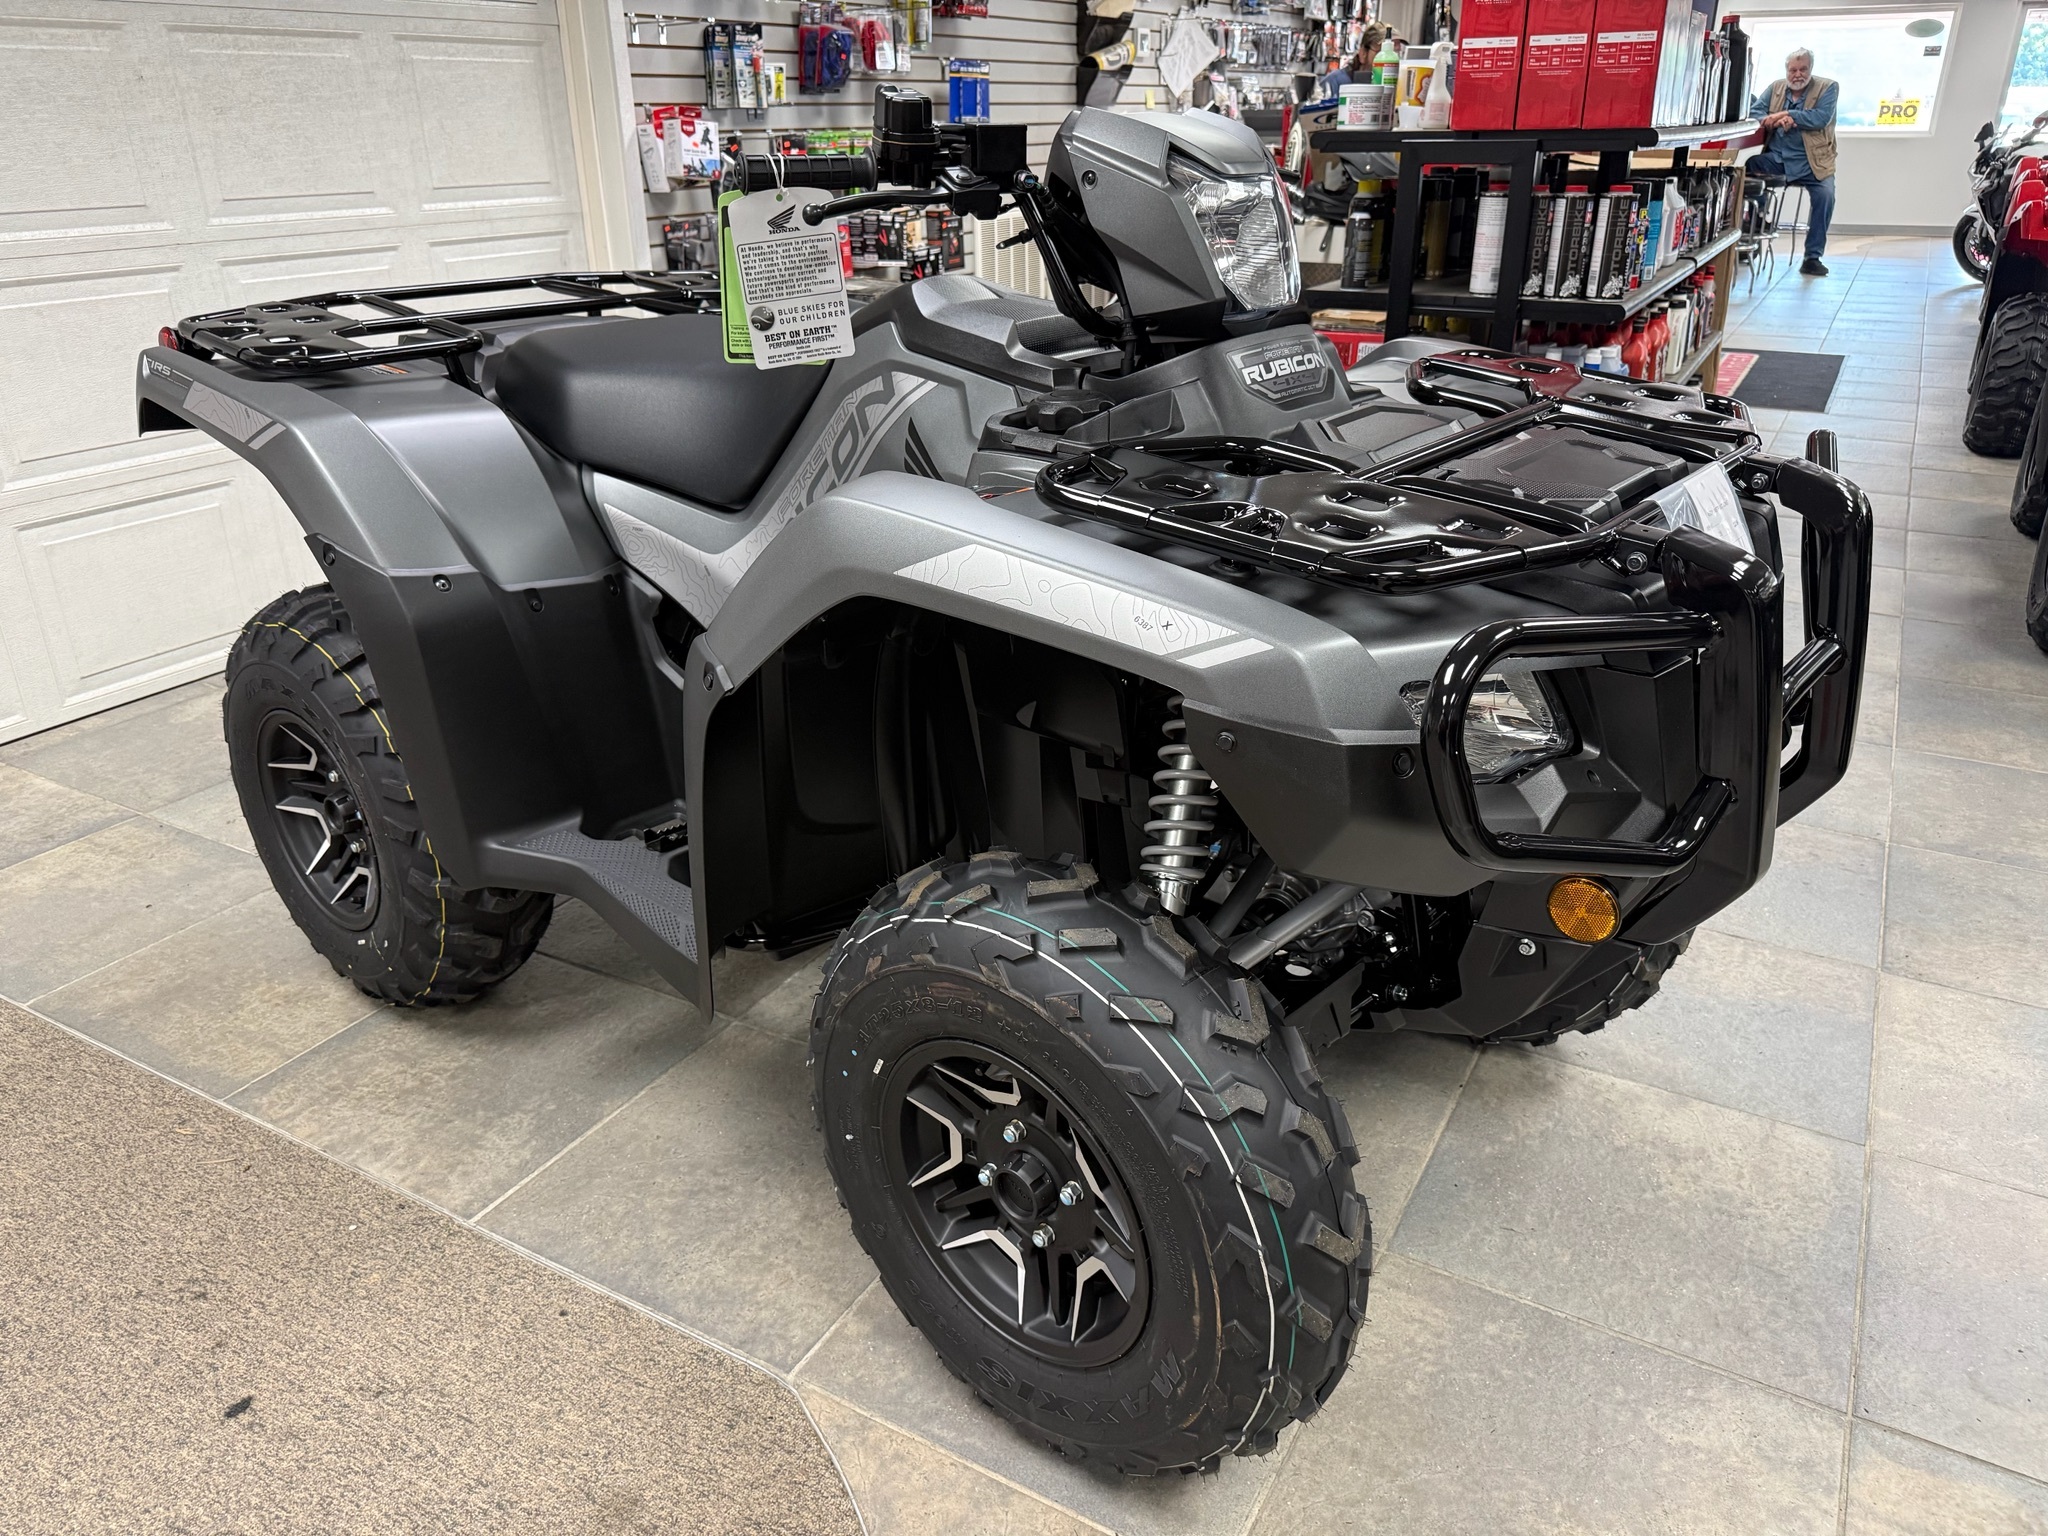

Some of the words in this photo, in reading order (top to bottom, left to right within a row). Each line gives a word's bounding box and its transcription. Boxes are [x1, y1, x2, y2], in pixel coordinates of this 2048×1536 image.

[1879, 104, 1918, 118] PRO
[769, 227, 800, 235] HONDA
[1531, 198, 1549, 276] OTORBIKE
[1567, 198, 1586, 277] OTORBIKE
[1610, 198, 1630, 277] OTORBIKE
[778, 307, 798, 316] BLUE
[801, 302, 825, 315] SKIES
[828, 300, 844, 310] FOR
[780, 317, 798, 325] OUR
[800, 309, 846, 322] CHILDREN
[764, 331, 787, 342] BEST
[789, 329, 801, 338] ON
[768, 337, 811, 350] PERFORMANCE
[150, 359, 172, 376] IRS
[1241, 352, 1325, 385] RUBICON
[1273, 372, 1316, 387] 4X4
[1280, 386, 1307, 397] AUTOMATIC
[776, 390, 859, 524] FOREMAN
[1133, 614, 1154, 632] 6387
[245, 677, 349, 765] MAXXIS
[977, 1347, 1184, 1425] MAXXIS
